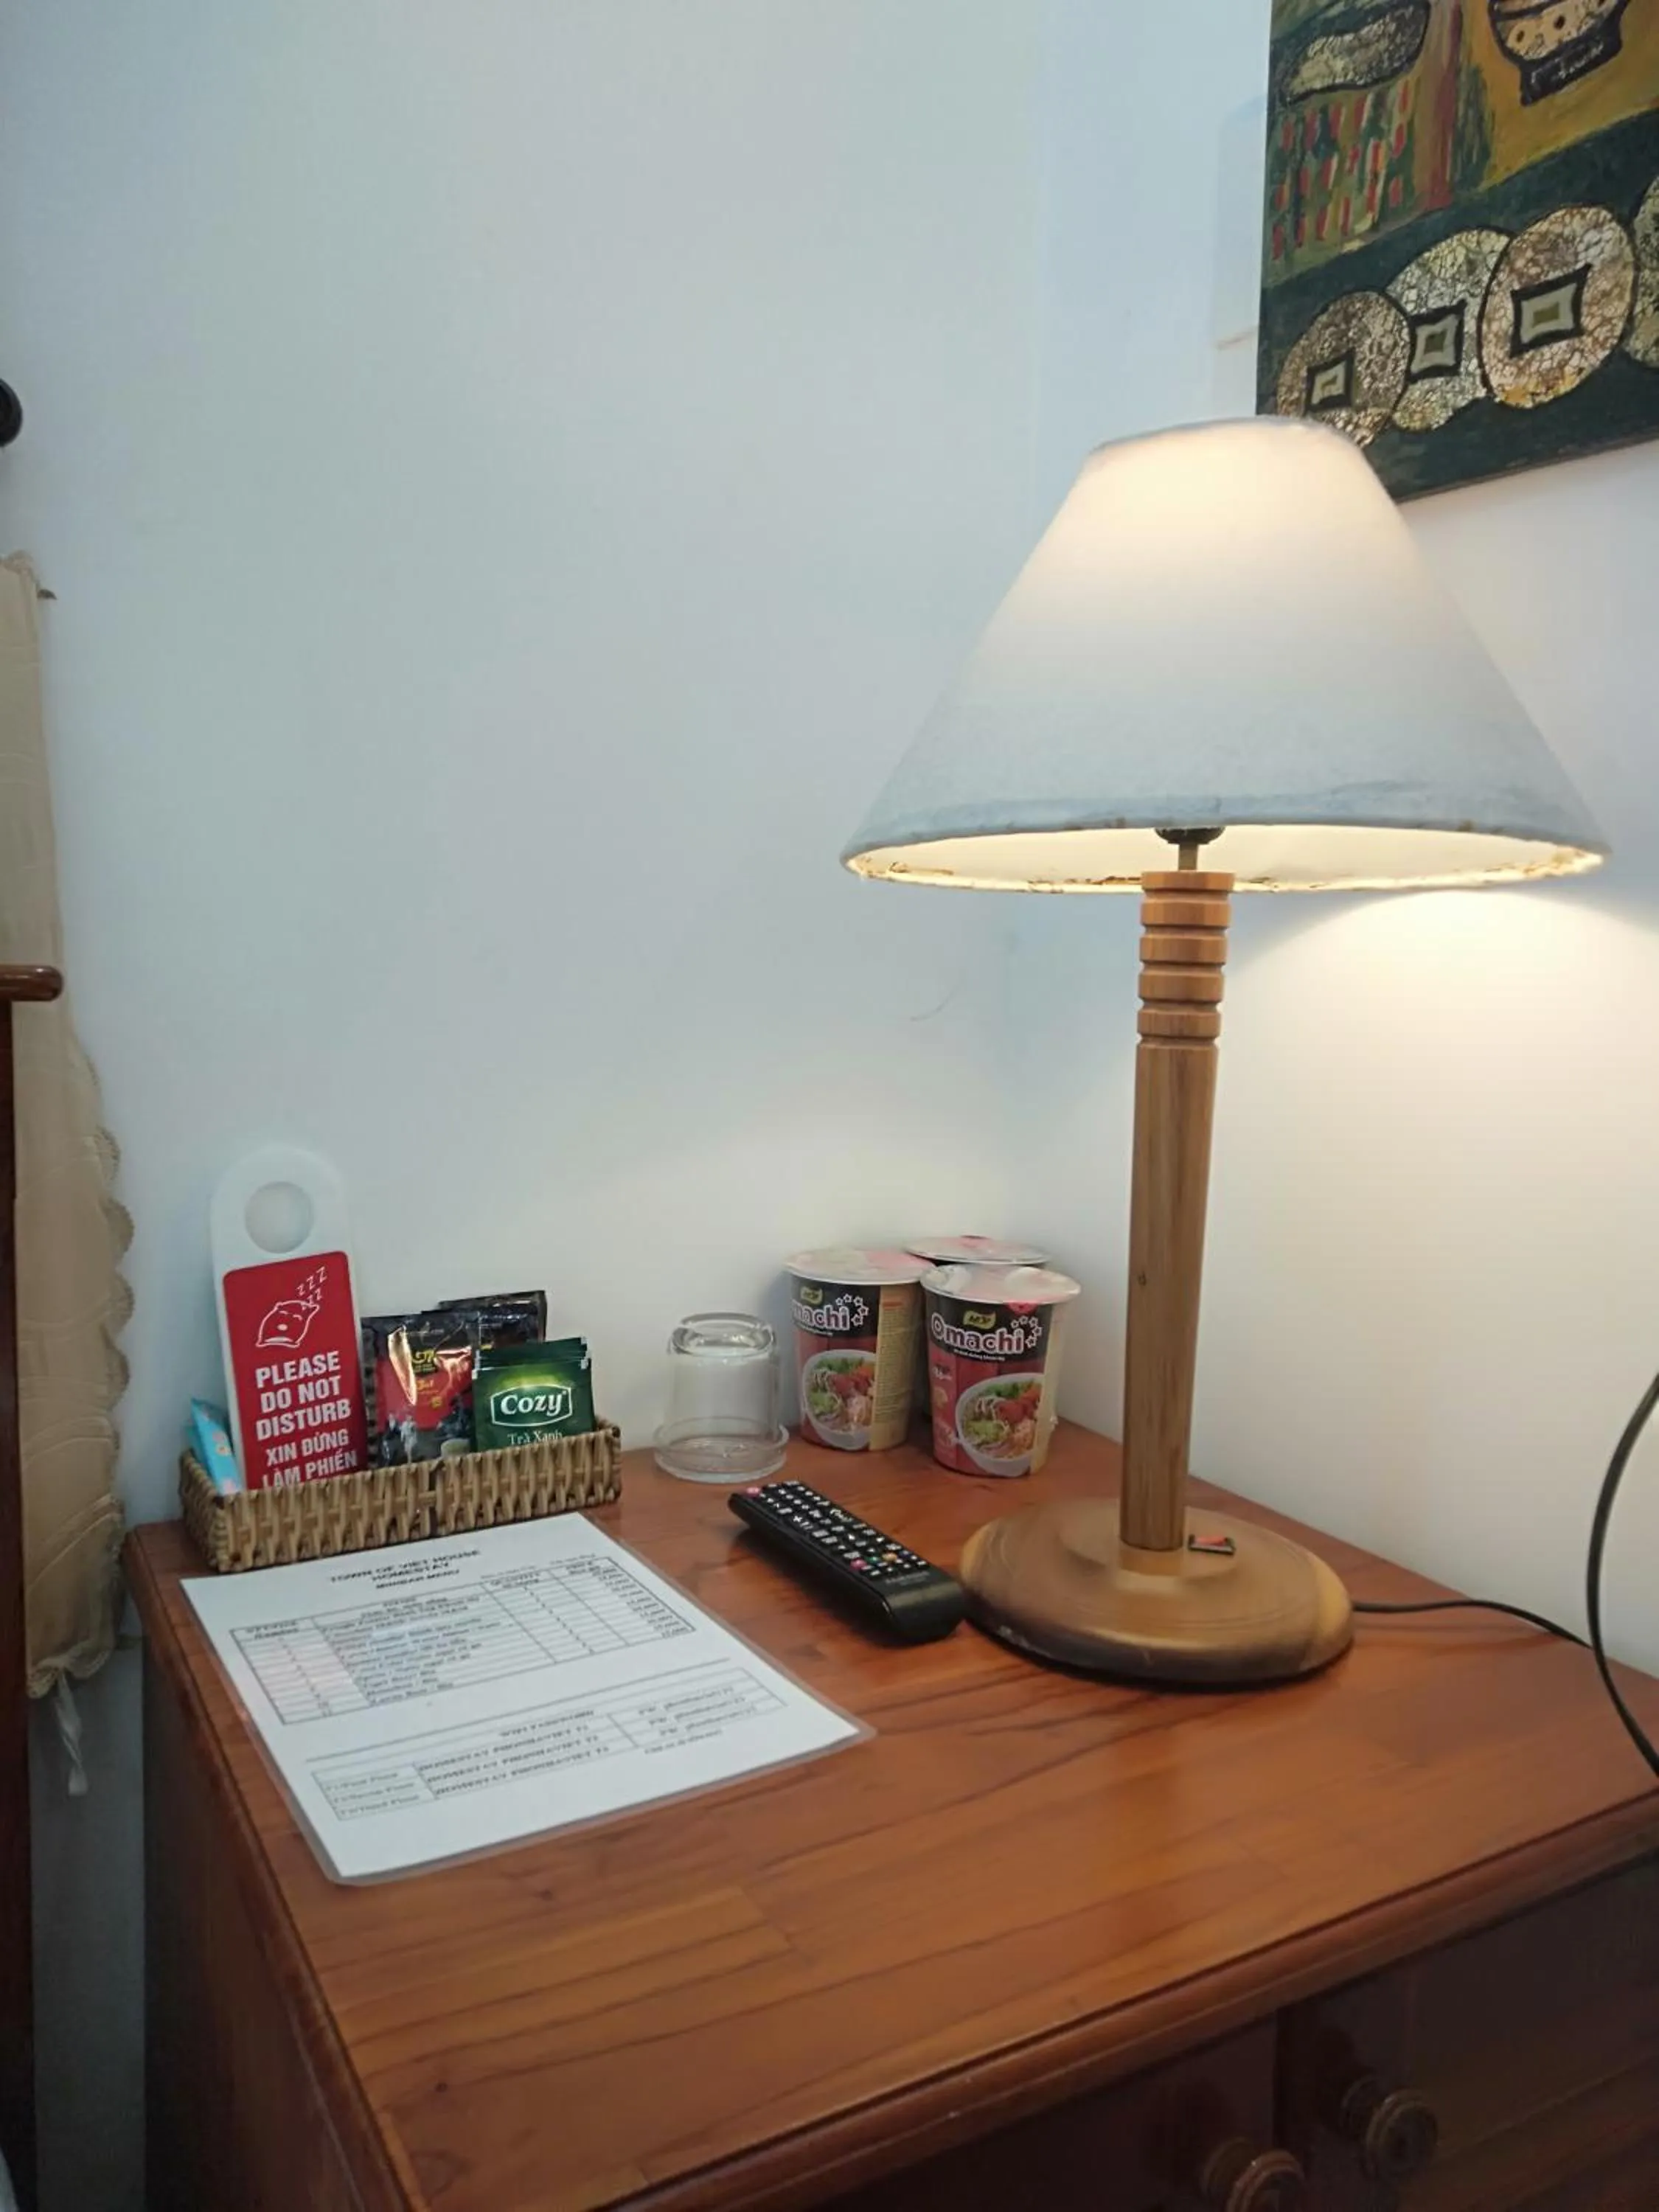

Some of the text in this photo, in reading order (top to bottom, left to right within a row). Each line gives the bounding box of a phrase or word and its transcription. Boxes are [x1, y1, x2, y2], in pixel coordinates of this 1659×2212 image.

[931, 1312, 1024, 1354] Omachi
[255, 1351, 341, 1388] PLEASE
[260, 1375, 341, 1413] DO NOT
[501, 1392, 563, 1416] Cozy
[256, 1399, 351, 1440] DISTURB
[266, 1441, 297, 1467] XIN
[262, 1466, 301, 1489] LÀM
